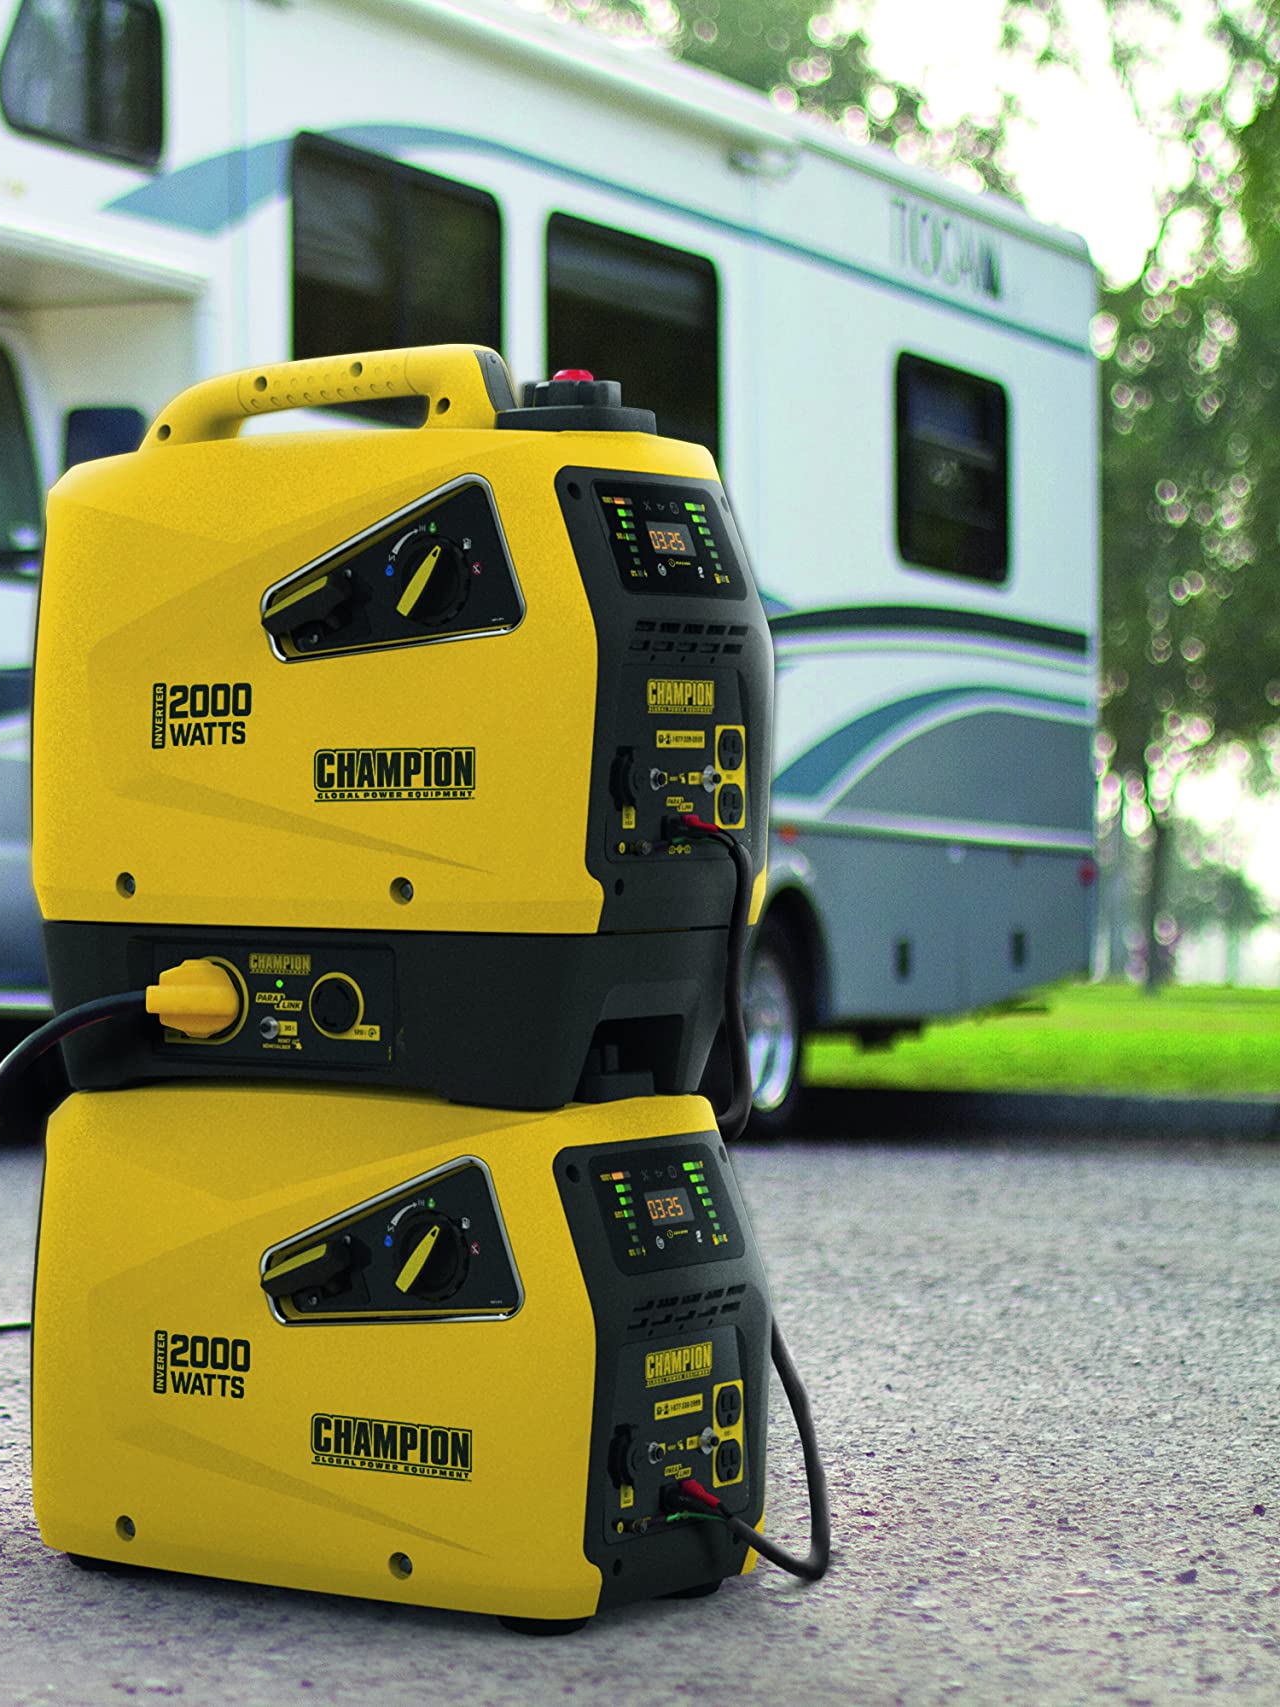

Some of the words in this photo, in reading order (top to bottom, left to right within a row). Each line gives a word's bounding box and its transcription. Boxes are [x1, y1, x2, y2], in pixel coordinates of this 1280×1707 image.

[169, 683, 252, 718] 2000
[648, 681, 714, 706] CHAMPION
[153, 684, 165, 747] INVERTER
[170, 721, 246, 747] WATTS
[317, 750, 474, 788] CHAMPION
[317, 791, 360, 799] GLOBAL
[363, 791, 403, 799] POWER
[407, 790, 474, 799] EQUIPMENT
[249, 954, 311, 970] CHAMPION
[280, 1001, 301, 1010] LINK
[155, 1332, 167, 1391] INVERTER
[170, 1334, 251, 1372] 2000
[646, 1344, 712, 1379] CHAMPION
[170, 1371, 245, 1399] WATTS
[313, 1415, 469, 1468] CHAMPION
[314, 1455, 357, 1466] GLOBAL
[359, 1460, 399, 1471] POWER
[403, 1466, 470, 1479] EQUIPMENT
